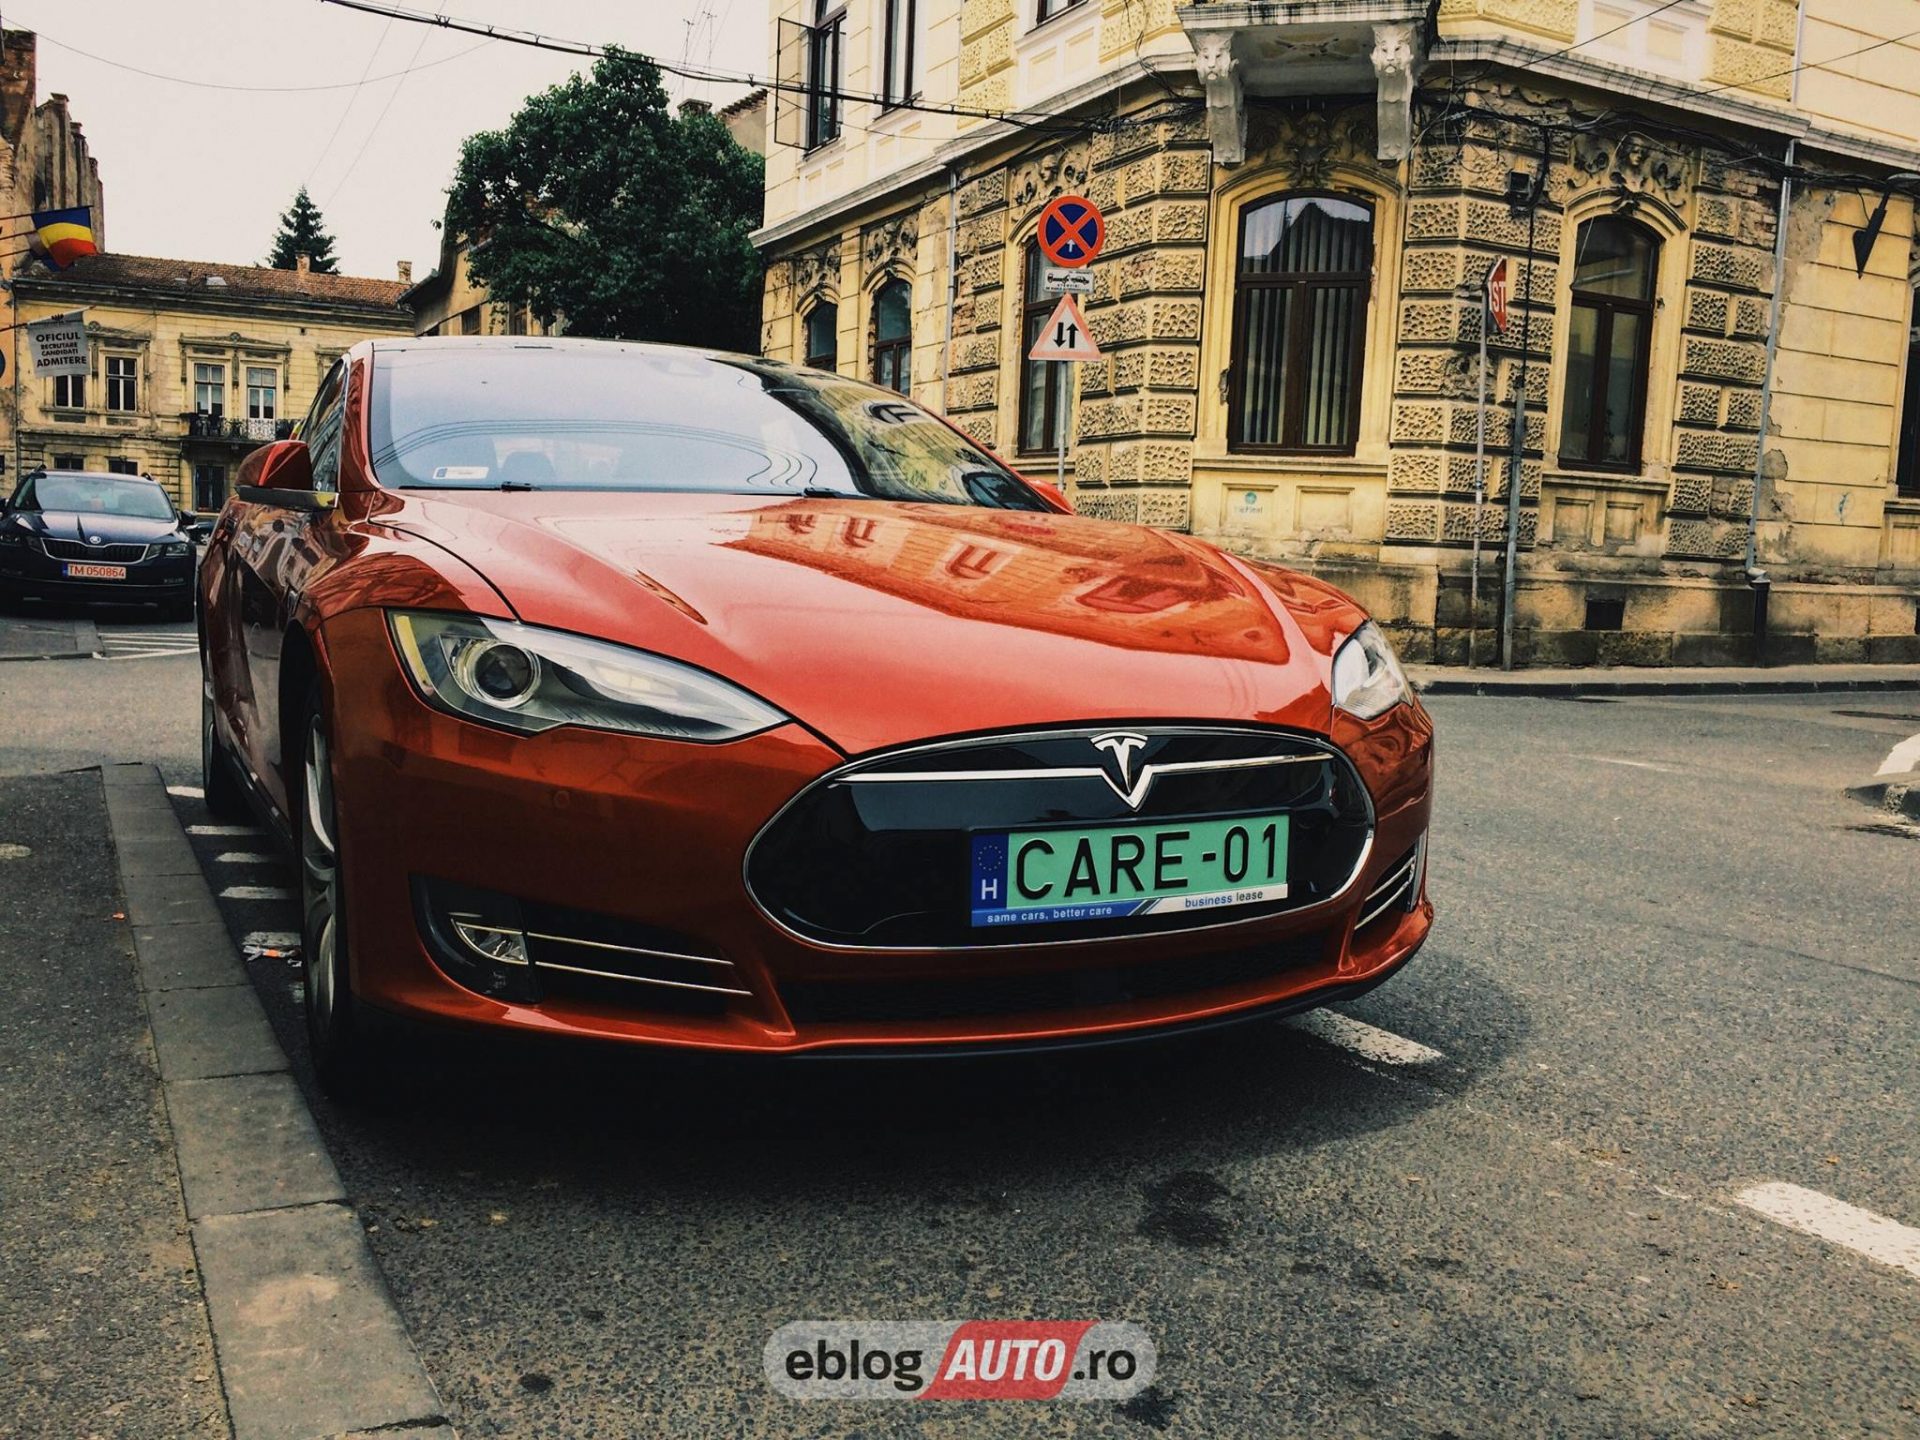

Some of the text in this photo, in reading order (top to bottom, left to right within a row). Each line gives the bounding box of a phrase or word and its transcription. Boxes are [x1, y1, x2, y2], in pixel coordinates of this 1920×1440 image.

[36, 332, 81, 342] OFICIUL
[37, 356, 87, 368] ADMITERE
[69, 565, 125, 577] TM 050864
[1016, 823, 1277, 900] CARE-01
[981, 878, 998, 900] H
[1185, 890, 1264, 908] business lease
[987, 905, 1113, 923] same cars, better care
